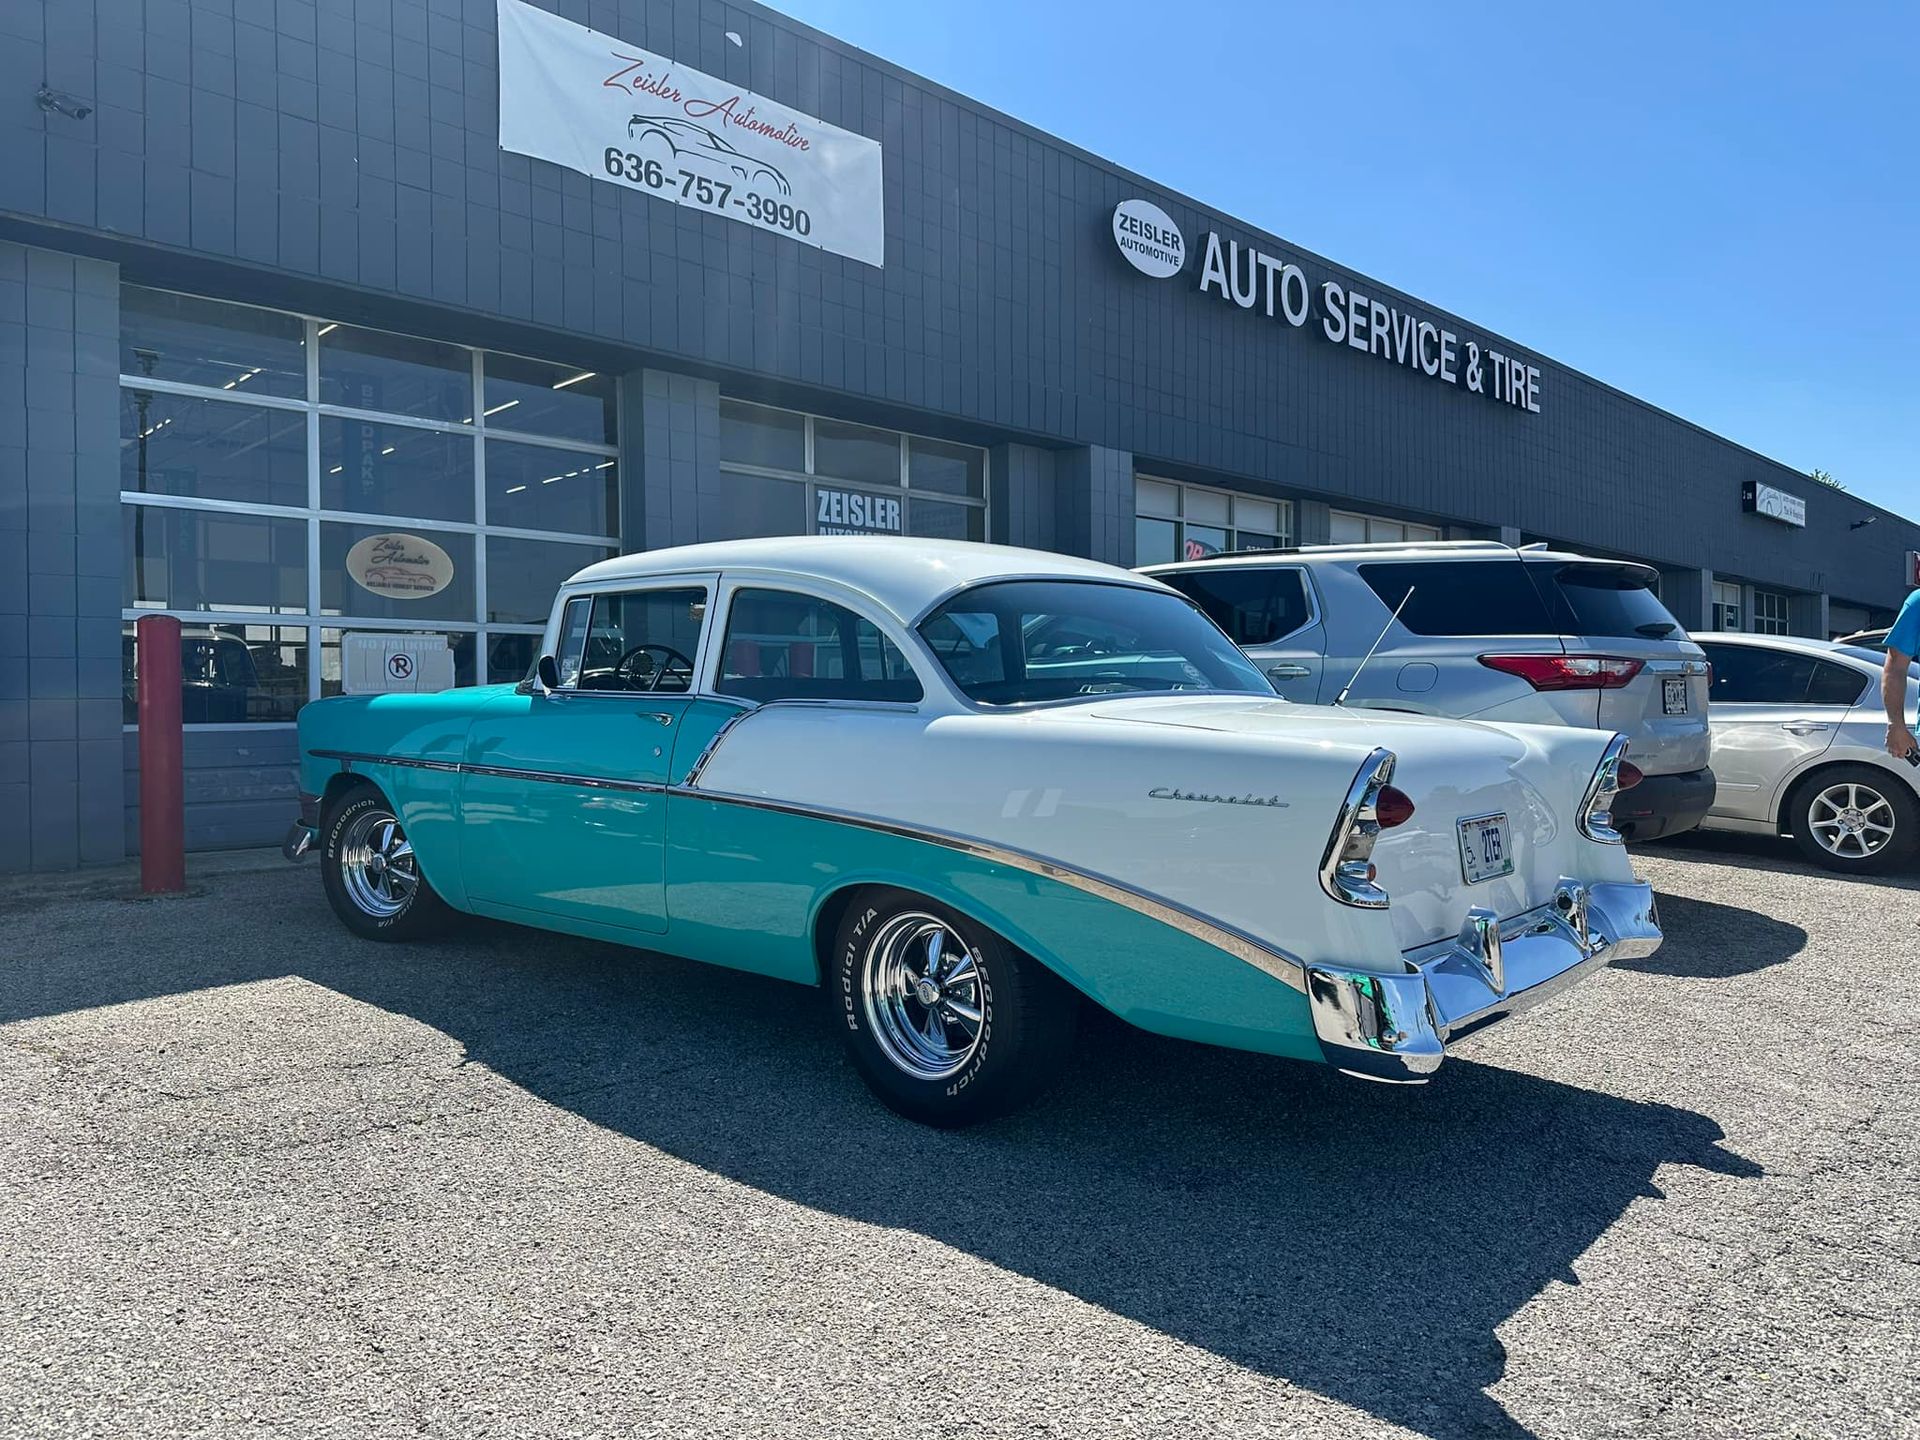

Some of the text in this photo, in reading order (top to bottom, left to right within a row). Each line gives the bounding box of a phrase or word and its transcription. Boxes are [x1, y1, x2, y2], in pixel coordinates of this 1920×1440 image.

[603, 51, 810, 152] Zeisler Automotive
[604, 147, 811, 237] 636-757-3990
[1118, 212, 1181, 252] ZEISLER
[1119, 236, 1180, 268] AUTOMOTIVE
[1200, 231, 1541, 414] AUTO SERVICE & TIRE
[817, 490, 900, 530] ZEISLER
[328, 799, 375, 859] BFGoodrich
[1149, 788, 1290, 808] Chevrolet
[842, 907, 879, 1031] Radial T/A
[946, 946, 994, 1097] BFGoodrich
